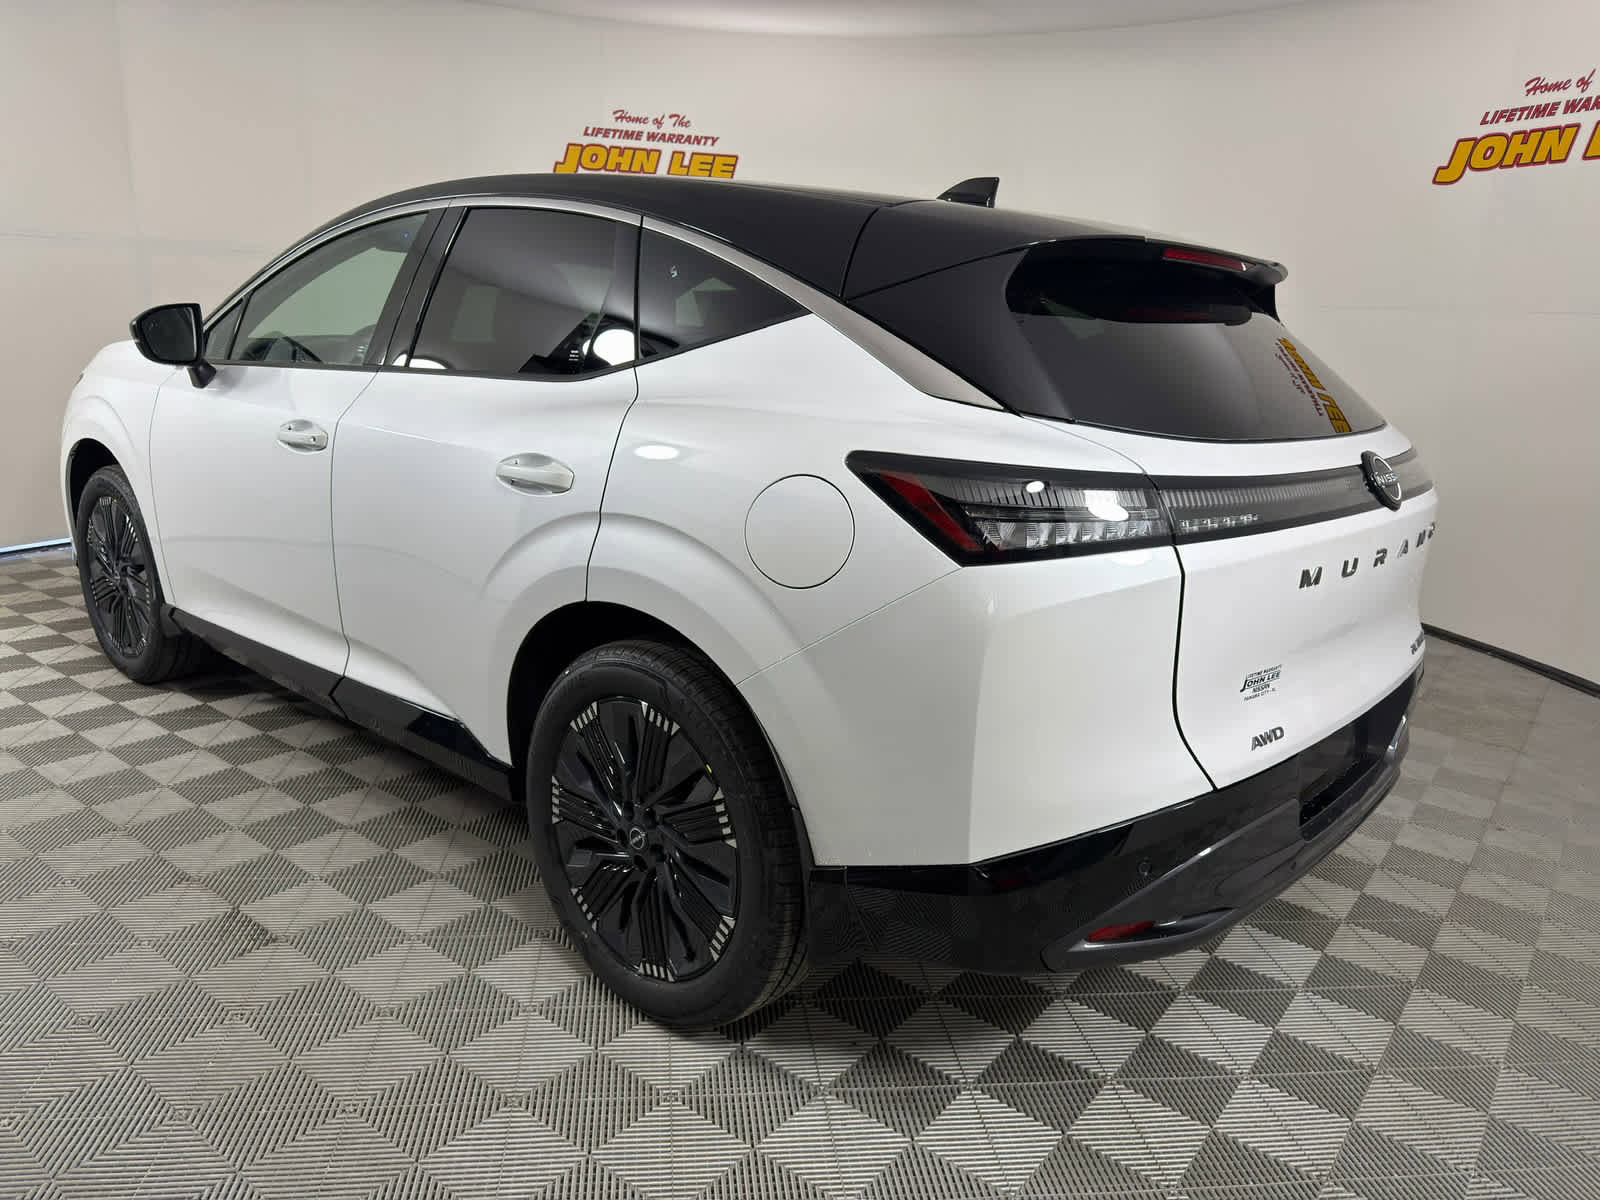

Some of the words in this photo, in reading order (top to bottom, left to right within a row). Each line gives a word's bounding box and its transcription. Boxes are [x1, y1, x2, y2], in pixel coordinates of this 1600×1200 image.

[1525, 76, 1572, 96] Home
[1576, 68, 1596, 93] of
[612, 109, 649, 125] Home
[652, 114, 665, 129] of
[668, 113, 692, 128] The
[1480, 101, 1561, 126] LIFETIME
[583, 126, 644, 142] LIFETIME
[646, 131, 720, 147] WARRANTY
[553, 143, 662, 174] JOHN
[667, 151, 739, 179] LEE
[1432, 123, 1581, 186] JOHN
[1240, 676, 1266, 692] JOHN
[1267, 671, 1281, 681] LEE
[1251, 726, 1285, 751] AWD
